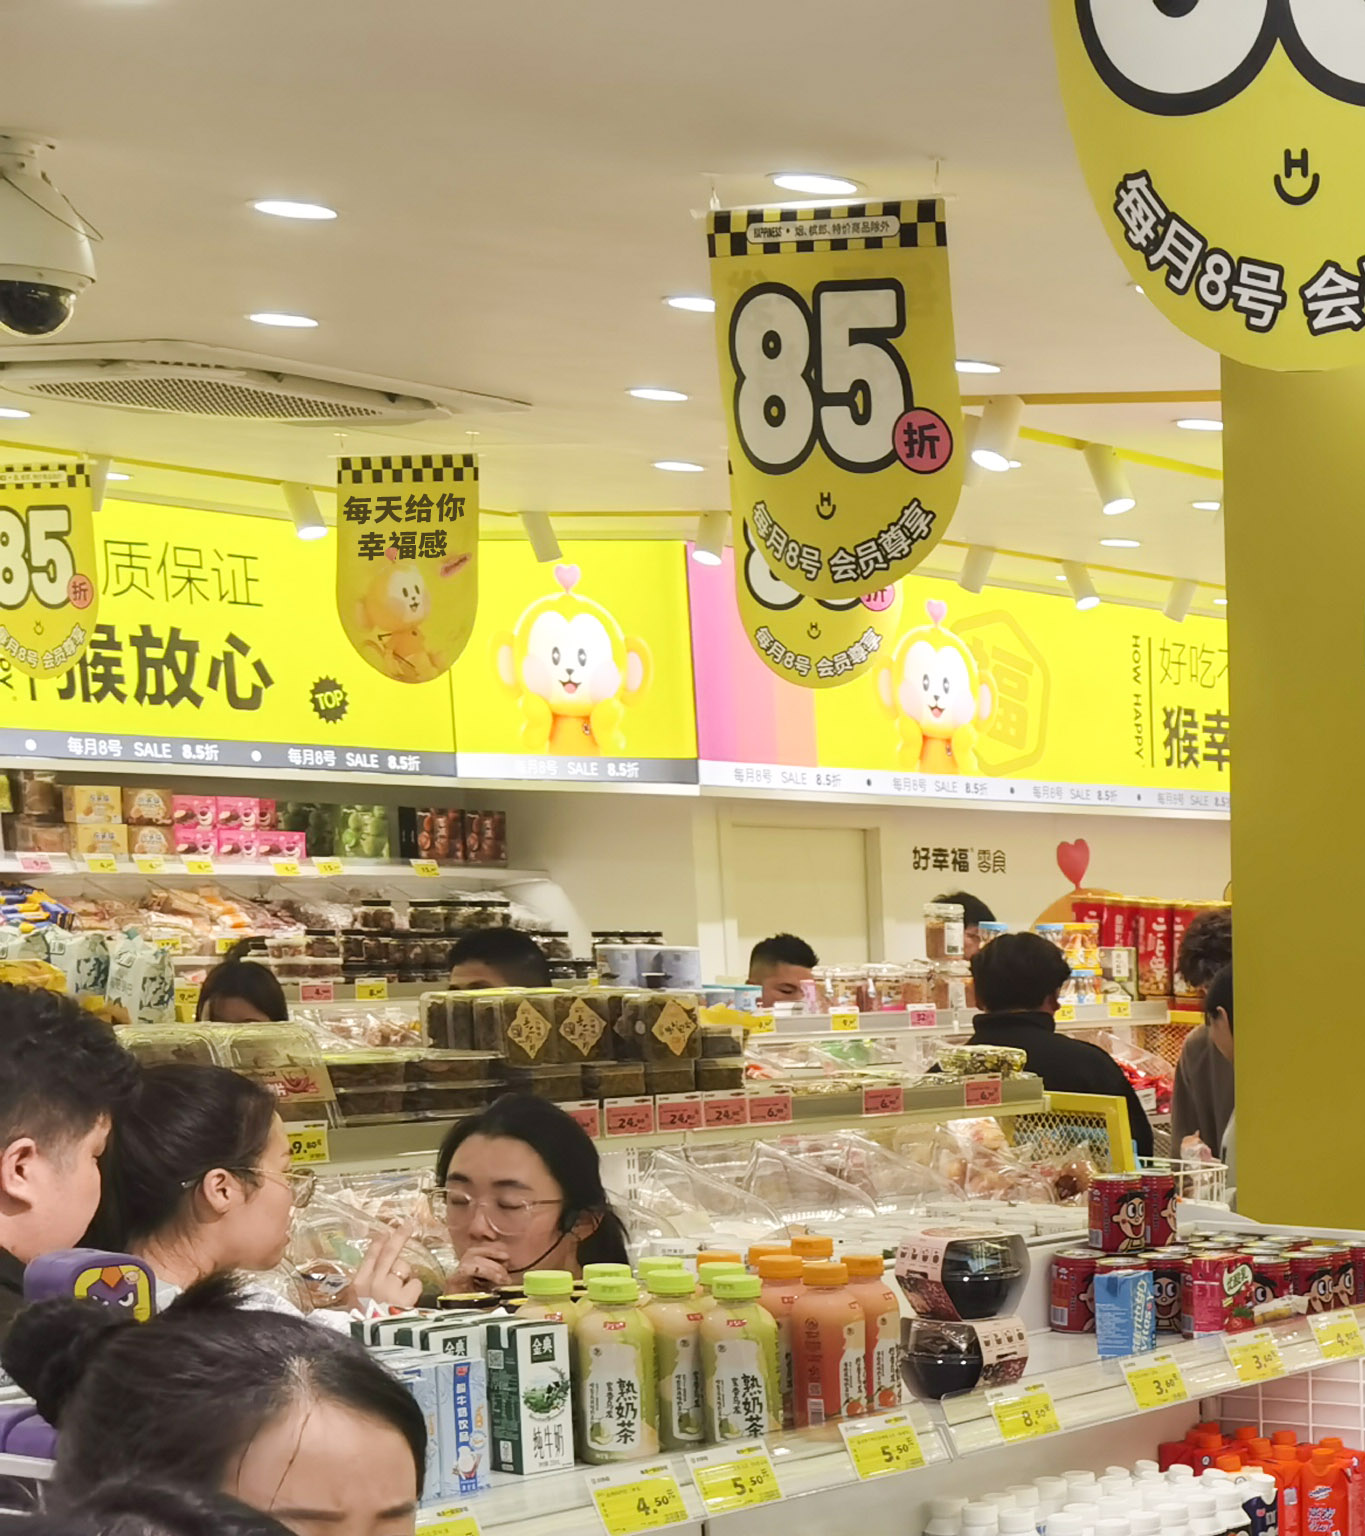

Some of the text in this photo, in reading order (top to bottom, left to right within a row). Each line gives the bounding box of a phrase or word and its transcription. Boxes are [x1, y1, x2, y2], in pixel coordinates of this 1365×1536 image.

[1113, 169, 1286, 333] 每月8号
[729, 278, 940, 474] 85 折
[343, 493, 466, 527] 每天给你
[357, 529, 448, 562] 幸福感
[748, 497, 937, 584] 每月8号 会员尊享
[101, 539, 264, 608] 质保证
[57, 624, 274, 711] 猴放心
[755, 625, 884, 678] 每月8号 会员尊享
[314, 687, 344, 709] TOP
[1130, 634, 1144, 761] HOW HAPPY
[67, 737, 220, 761] 每月8号 SALE 8.5折
[288, 748, 421, 772] 每月8号 SALE 8.5折
[567, 762, 598, 776] SALE
[607, 762, 639, 778] 8.5折
[781, 771, 807, 785] SALE
[934, 779, 958, 793] SALE
[1070, 788, 1091, 801] SALE
[912, 846, 970, 874] 好幸福
[531, 1337, 552, 1357] 金典
[615, 1377, 639, 1444] 熟奶茶
[741, 1373, 765, 1438] 熟奶茶
